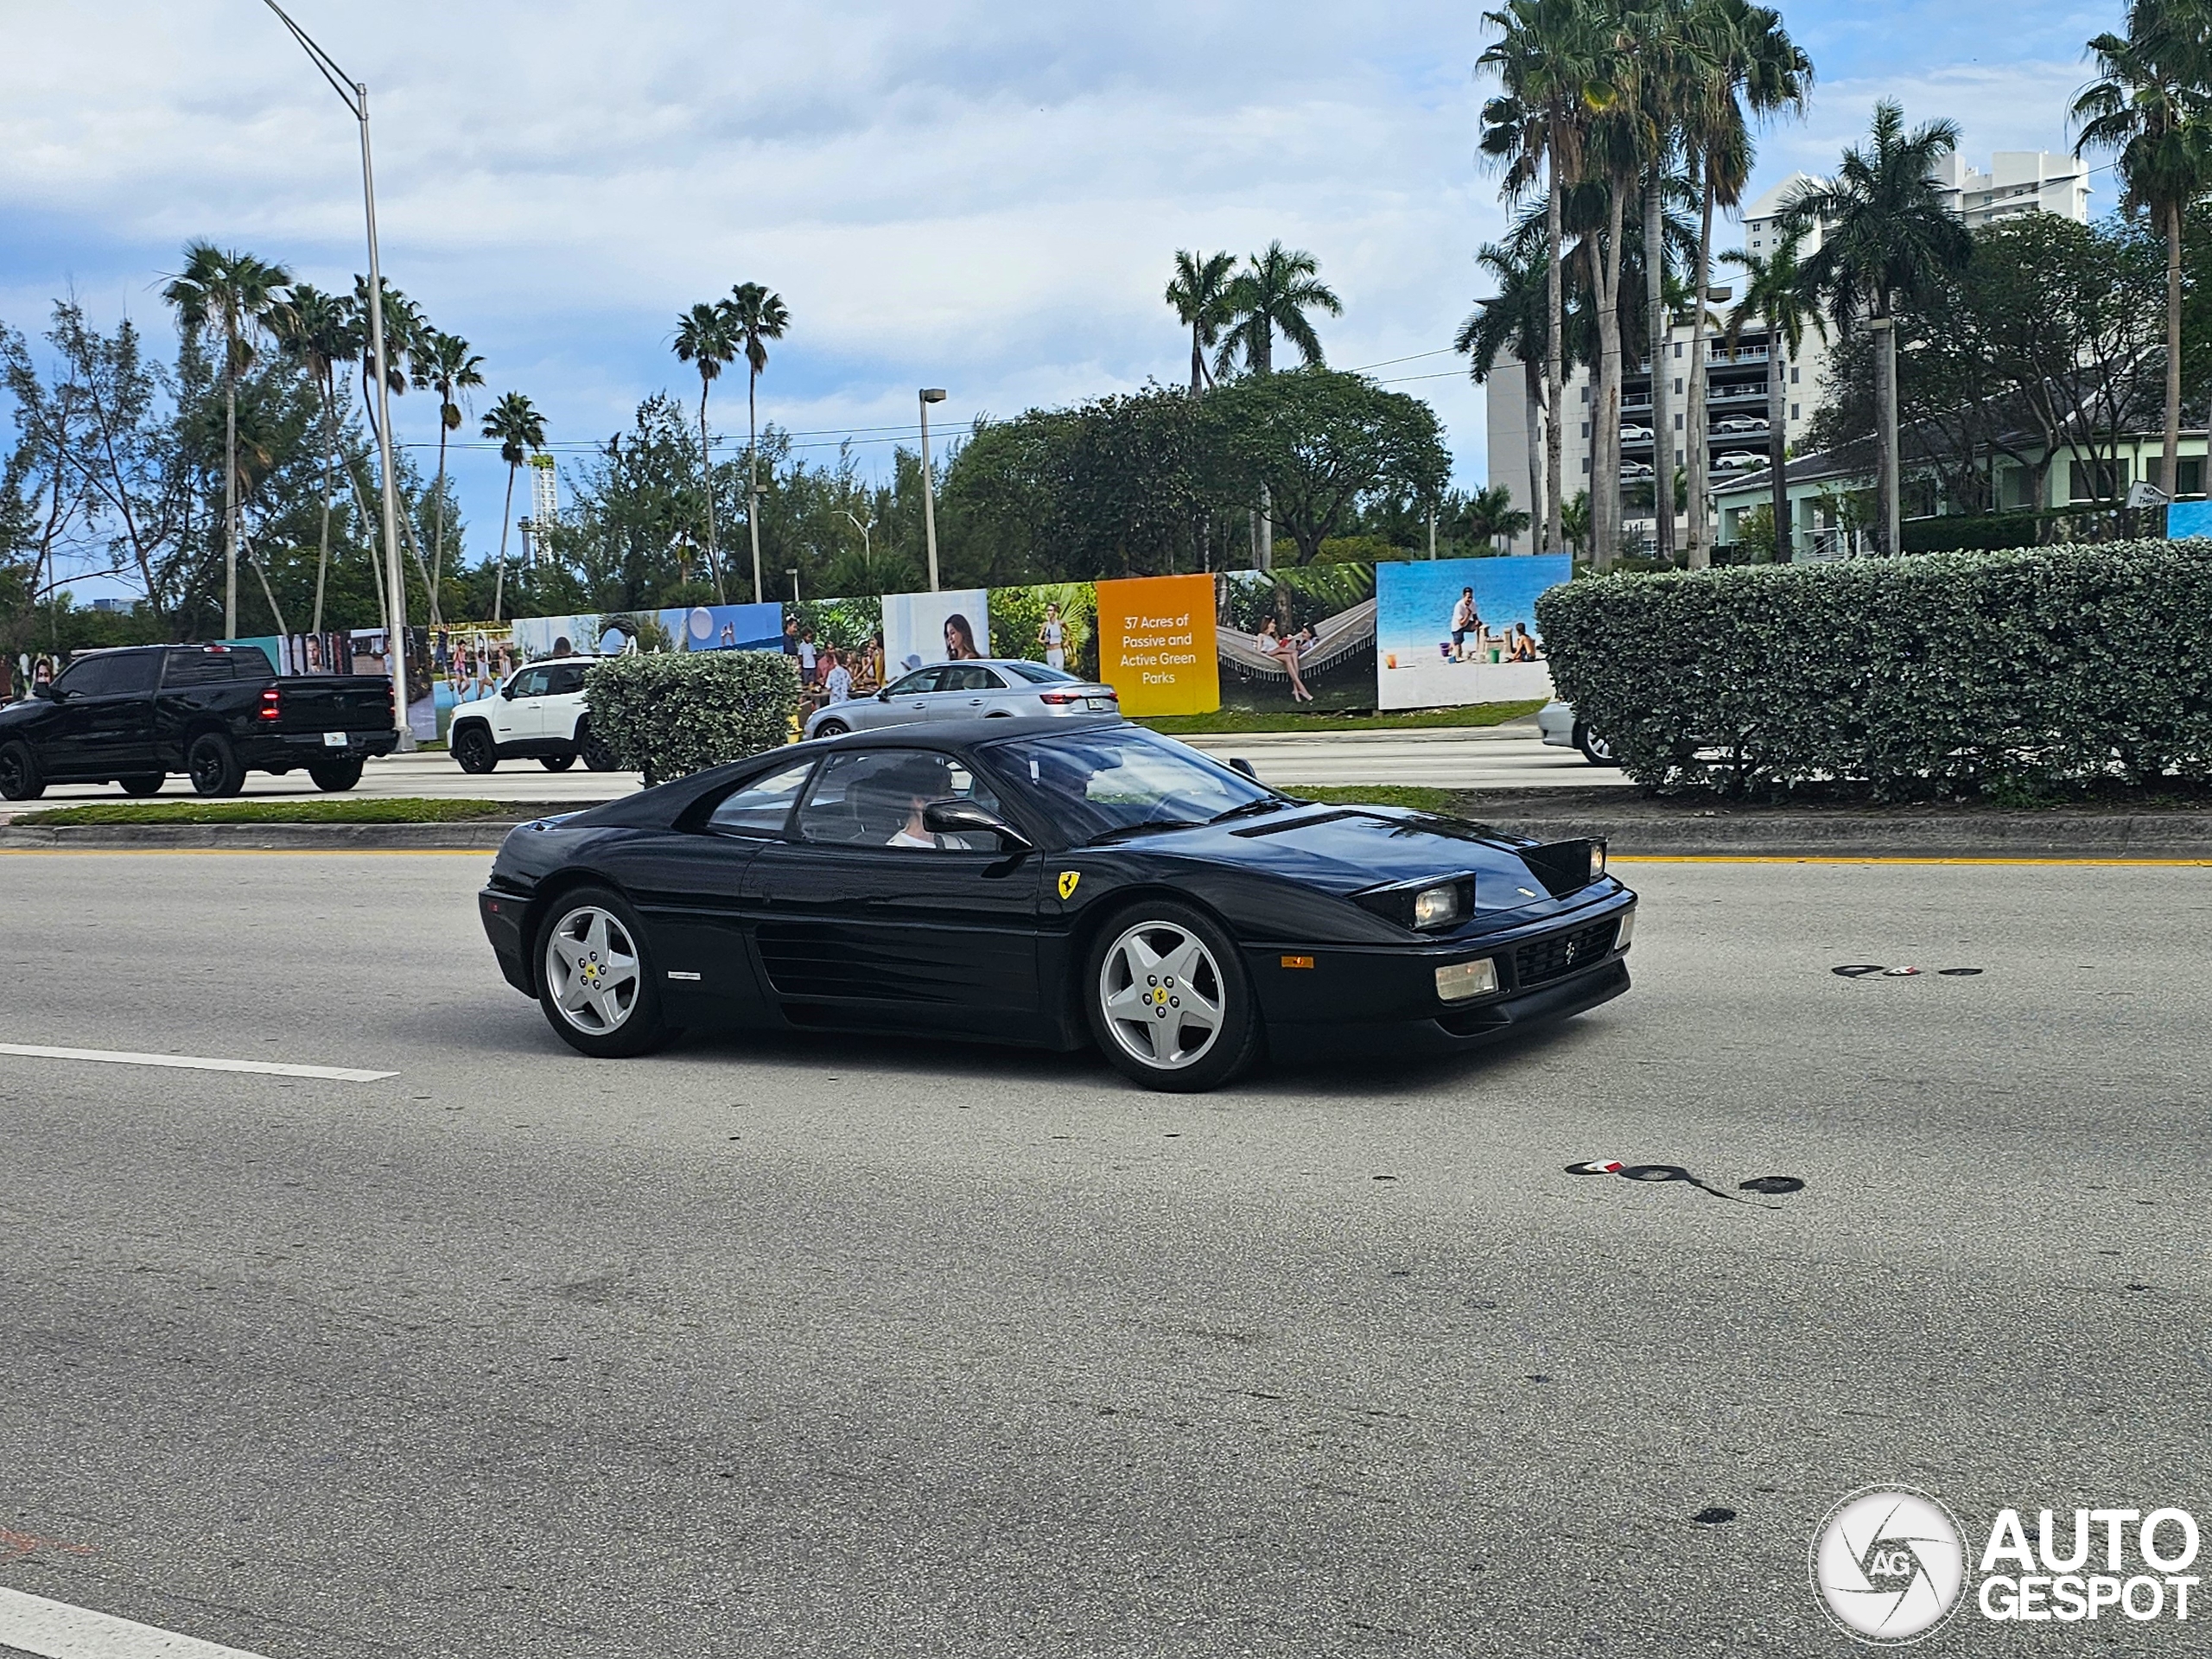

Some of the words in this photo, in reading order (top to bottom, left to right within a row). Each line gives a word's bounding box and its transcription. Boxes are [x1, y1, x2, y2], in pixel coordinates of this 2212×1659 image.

[2143, 486, 2156, 496] NO
[1124, 616, 1139, 630] 37
[1141, 616, 1173, 628] Acres
[1176, 613, 1189, 626] of
[1123, 634, 1166, 648] Passive
[1168, 632, 1192, 645] and
[1120, 653, 1157, 667] Active
[1160, 652, 1197, 664] Green
[1142, 671, 1176, 684] Parks
